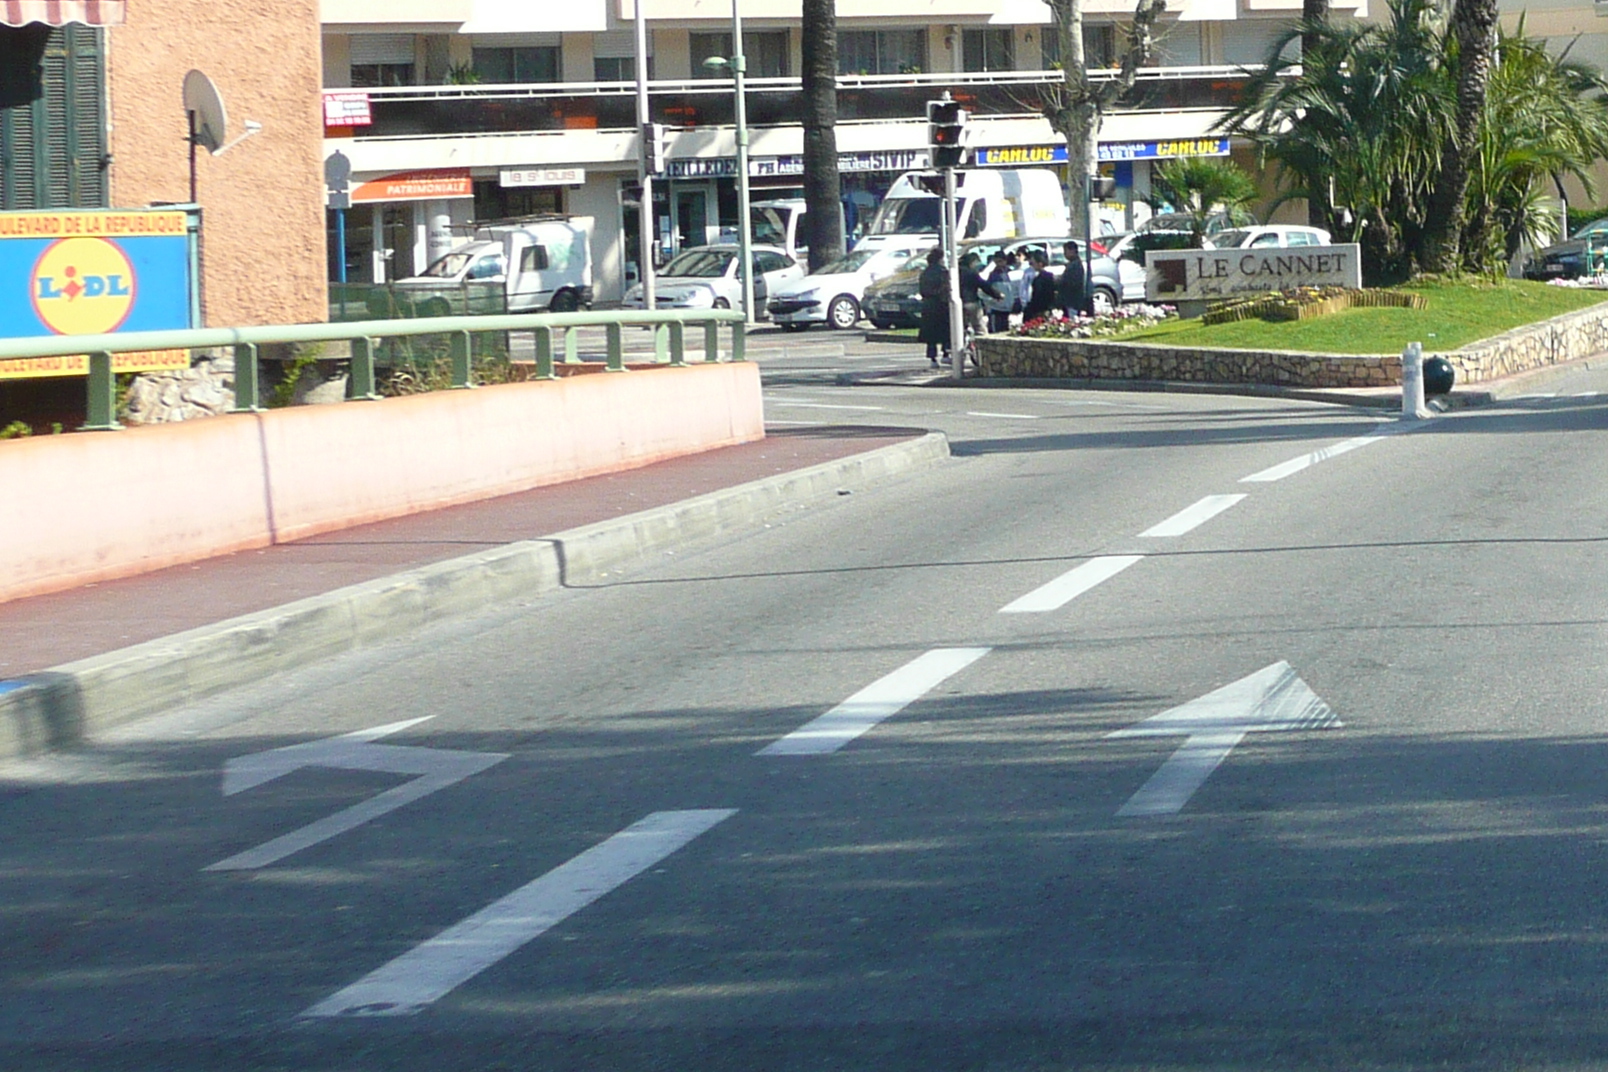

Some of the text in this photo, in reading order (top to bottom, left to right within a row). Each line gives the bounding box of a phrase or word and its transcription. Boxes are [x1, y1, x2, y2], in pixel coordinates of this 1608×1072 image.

[873, 150, 916, 169] SIVIP
[386, 182, 466, 195] PATRIMONIALE
[0, 216, 59, 235] ULEVARD
[65, 216, 82, 234] DE
[86, 216, 100, 233] LA
[1197, 253, 1347, 279] LE CANNET
[0, 356, 62, 374] ULEVARD
[112, 349, 187, 367] EPUBLIQUE
